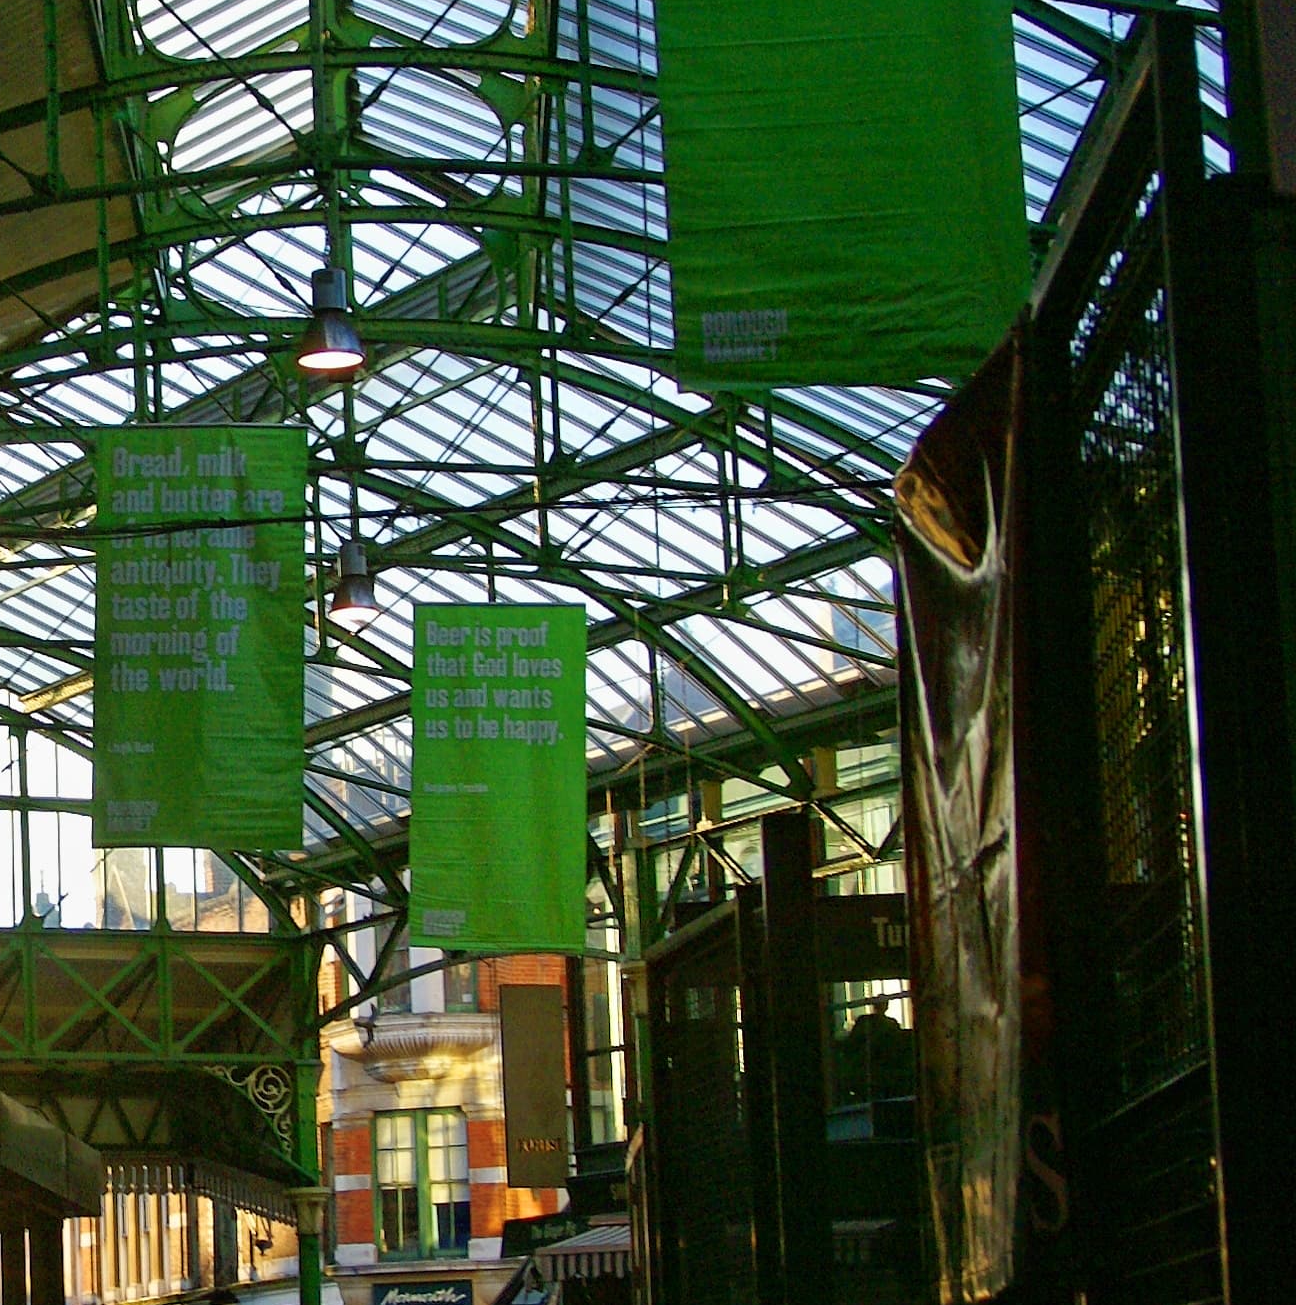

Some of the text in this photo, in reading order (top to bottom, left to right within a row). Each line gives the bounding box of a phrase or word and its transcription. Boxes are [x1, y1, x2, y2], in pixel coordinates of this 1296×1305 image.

[113, 442, 246, 478] Bread, milk
[112, 481, 283, 513] and butter are
[111, 554, 281, 592] antiquity. They
[112, 591, 247, 621] taste of the
[111, 625, 240, 663] morning of
[426, 620, 549, 649] Beer is proof
[112, 660, 235, 692] the world.
[427, 652, 562, 678] that God loves
[426, 682, 552, 709] us and wants
[425, 714, 564, 745] us to be happy.
